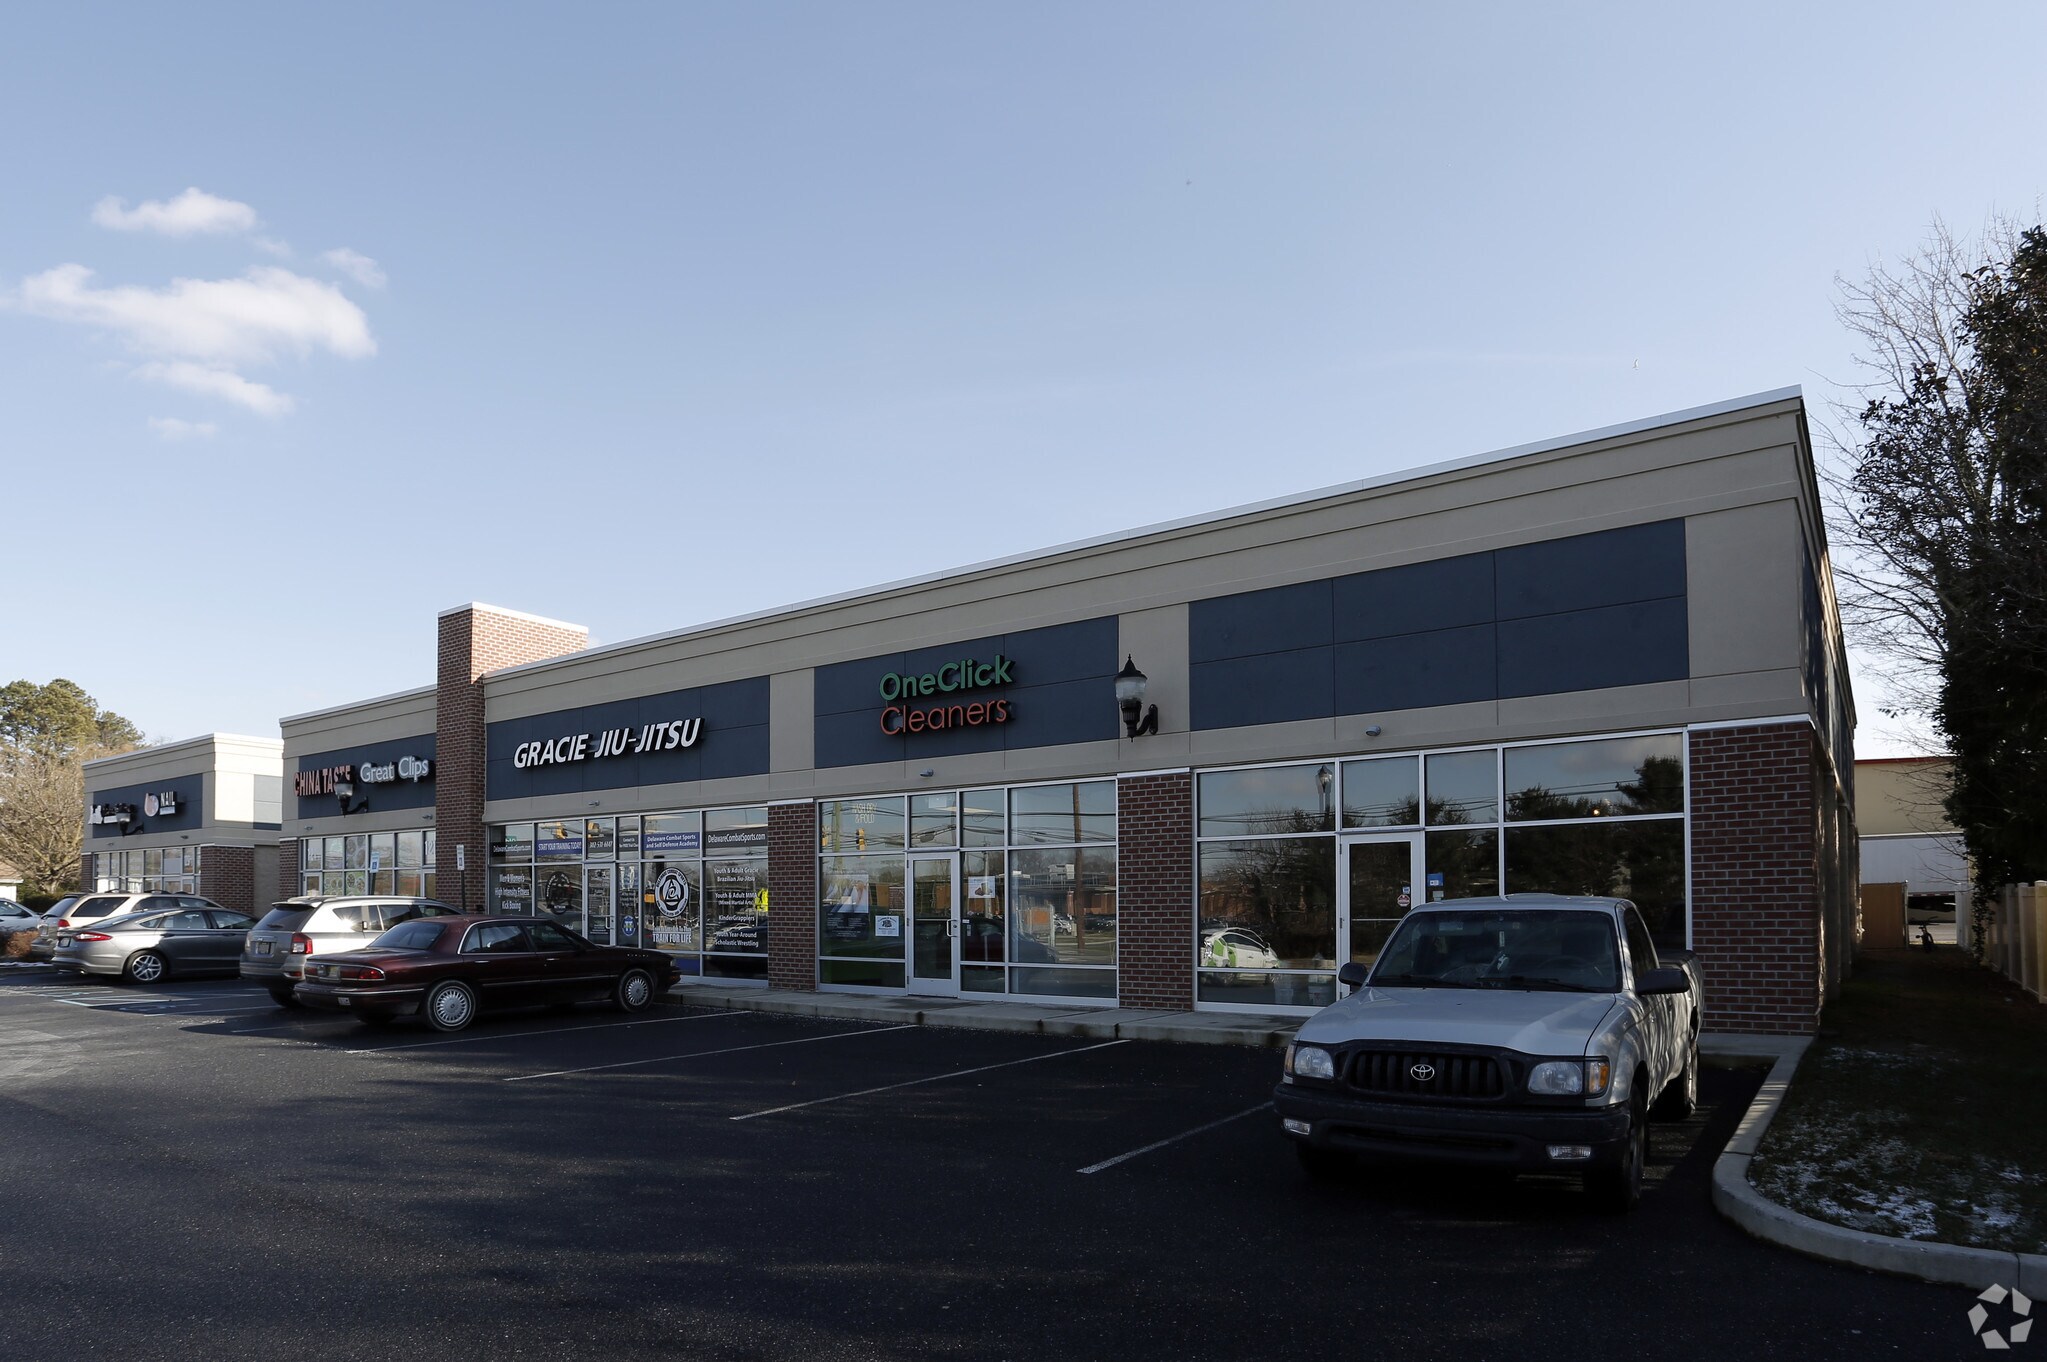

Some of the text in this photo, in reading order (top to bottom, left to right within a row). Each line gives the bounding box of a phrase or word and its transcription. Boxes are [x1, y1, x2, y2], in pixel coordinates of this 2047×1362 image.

[879, 655, 1013, 701] OneClick
[880, 700, 1007, 735] Cleaners
[513, 718, 702, 769] GRACIE JIU-JITSU
[360, 755, 429, 783] Great Clips
[293, 770, 321, 797] CHINA
[679, 840, 698, 848] Academy
[707, 833, 766, 844] DelawareCombatSports.com
[653, 933, 692, 943] TRAIN FOR LIFE
